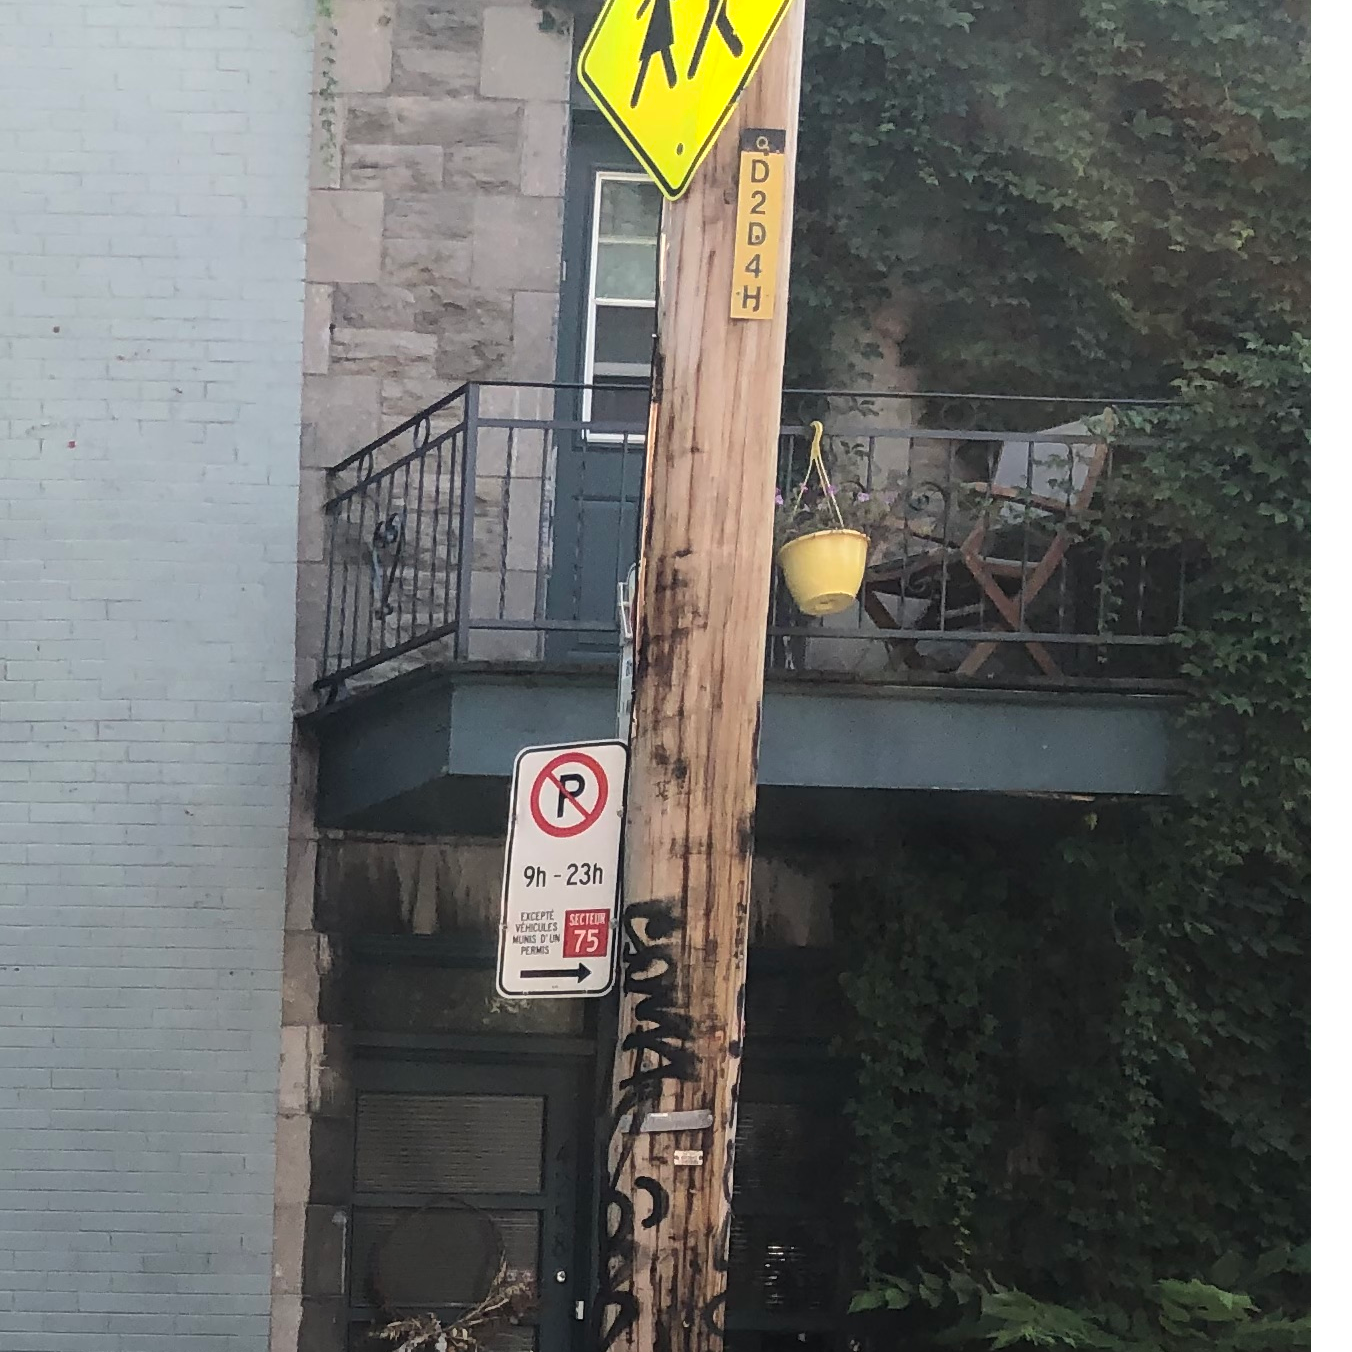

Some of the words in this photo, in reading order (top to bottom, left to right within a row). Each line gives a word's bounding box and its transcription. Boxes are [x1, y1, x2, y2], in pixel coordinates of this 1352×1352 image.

[523, 866, 546, 887] 9h
[566, 863, 603, 886] 23h
[520, 909, 554, 921] EXCEPTÉ
[569, 912, 606, 926] SECTEUR
[515, 921, 558, 933] VÉHICULES
[512, 935, 536, 944] MUNIS
[574, 929, 599, 953] 75
[520, 945, 549, 955] PERMIS
